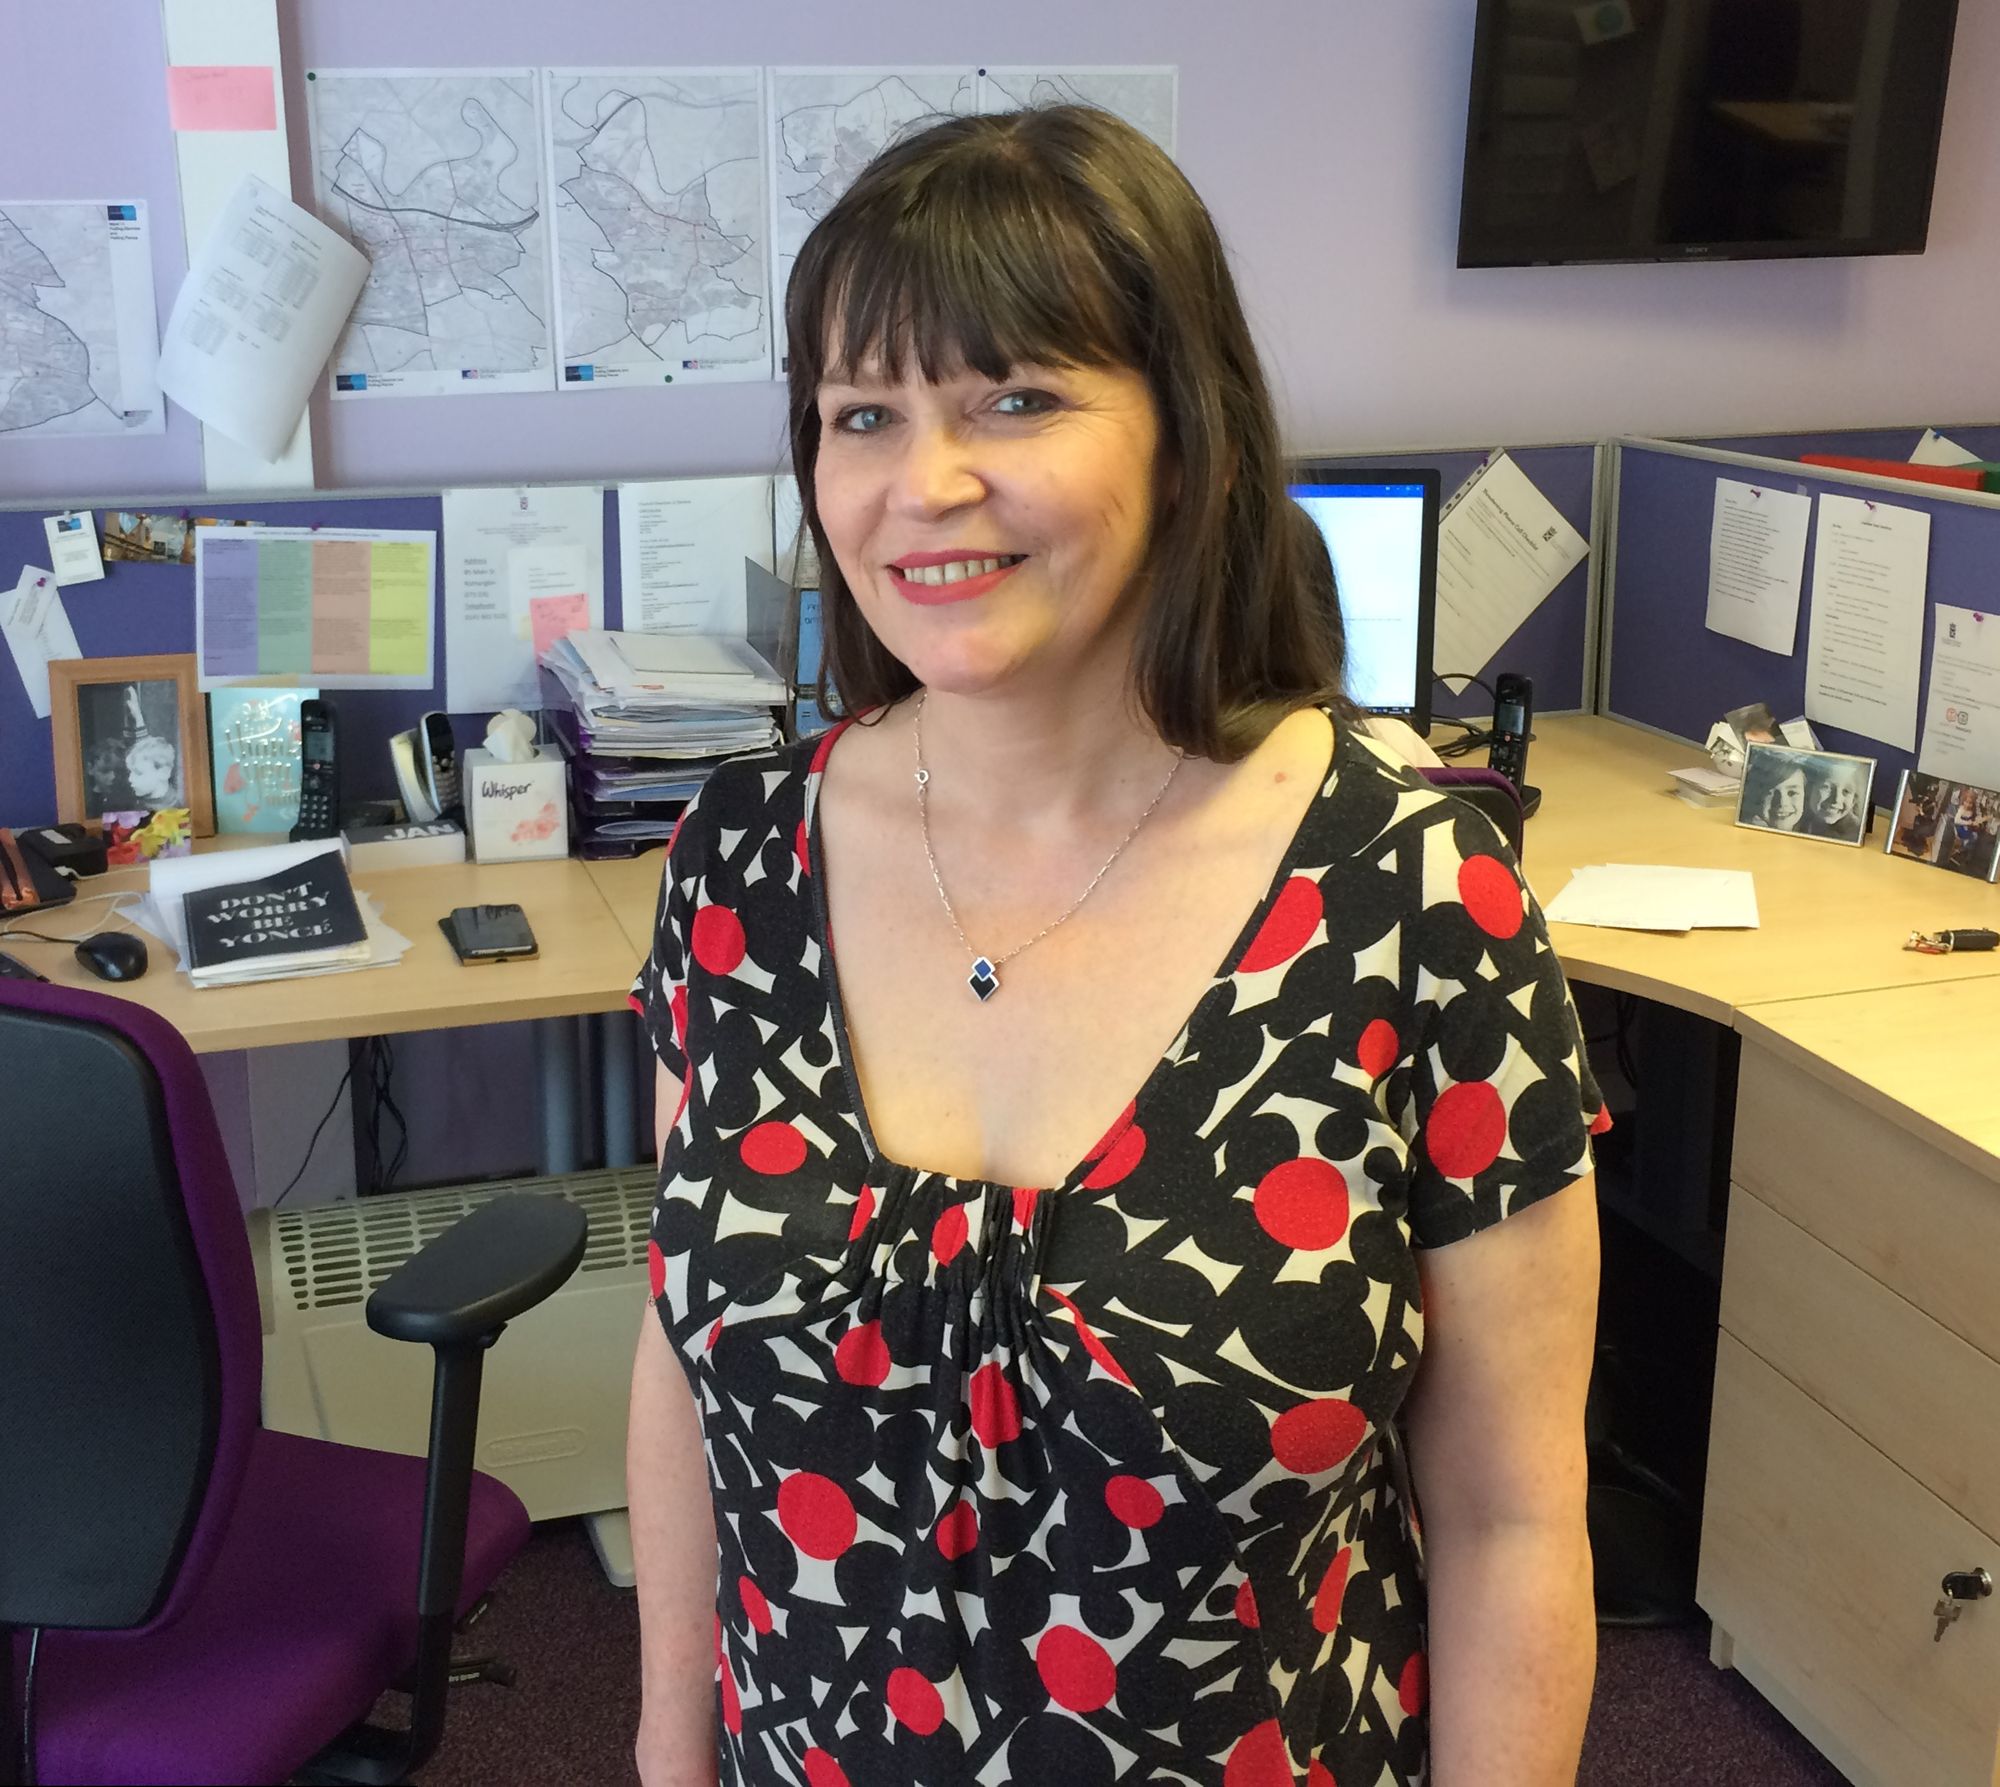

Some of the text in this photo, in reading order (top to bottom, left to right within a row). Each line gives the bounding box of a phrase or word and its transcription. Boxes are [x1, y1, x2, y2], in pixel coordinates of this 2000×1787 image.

[481, 780, 533, 800] Whisper
[383, 823, 456, 841] JAN
[207, 891, 330, 924] WORRY
[219, 881, 313, 910] DON'T
[219, 918, 333, 948] YONCÉ
[252, 916, 294, 930] BE
